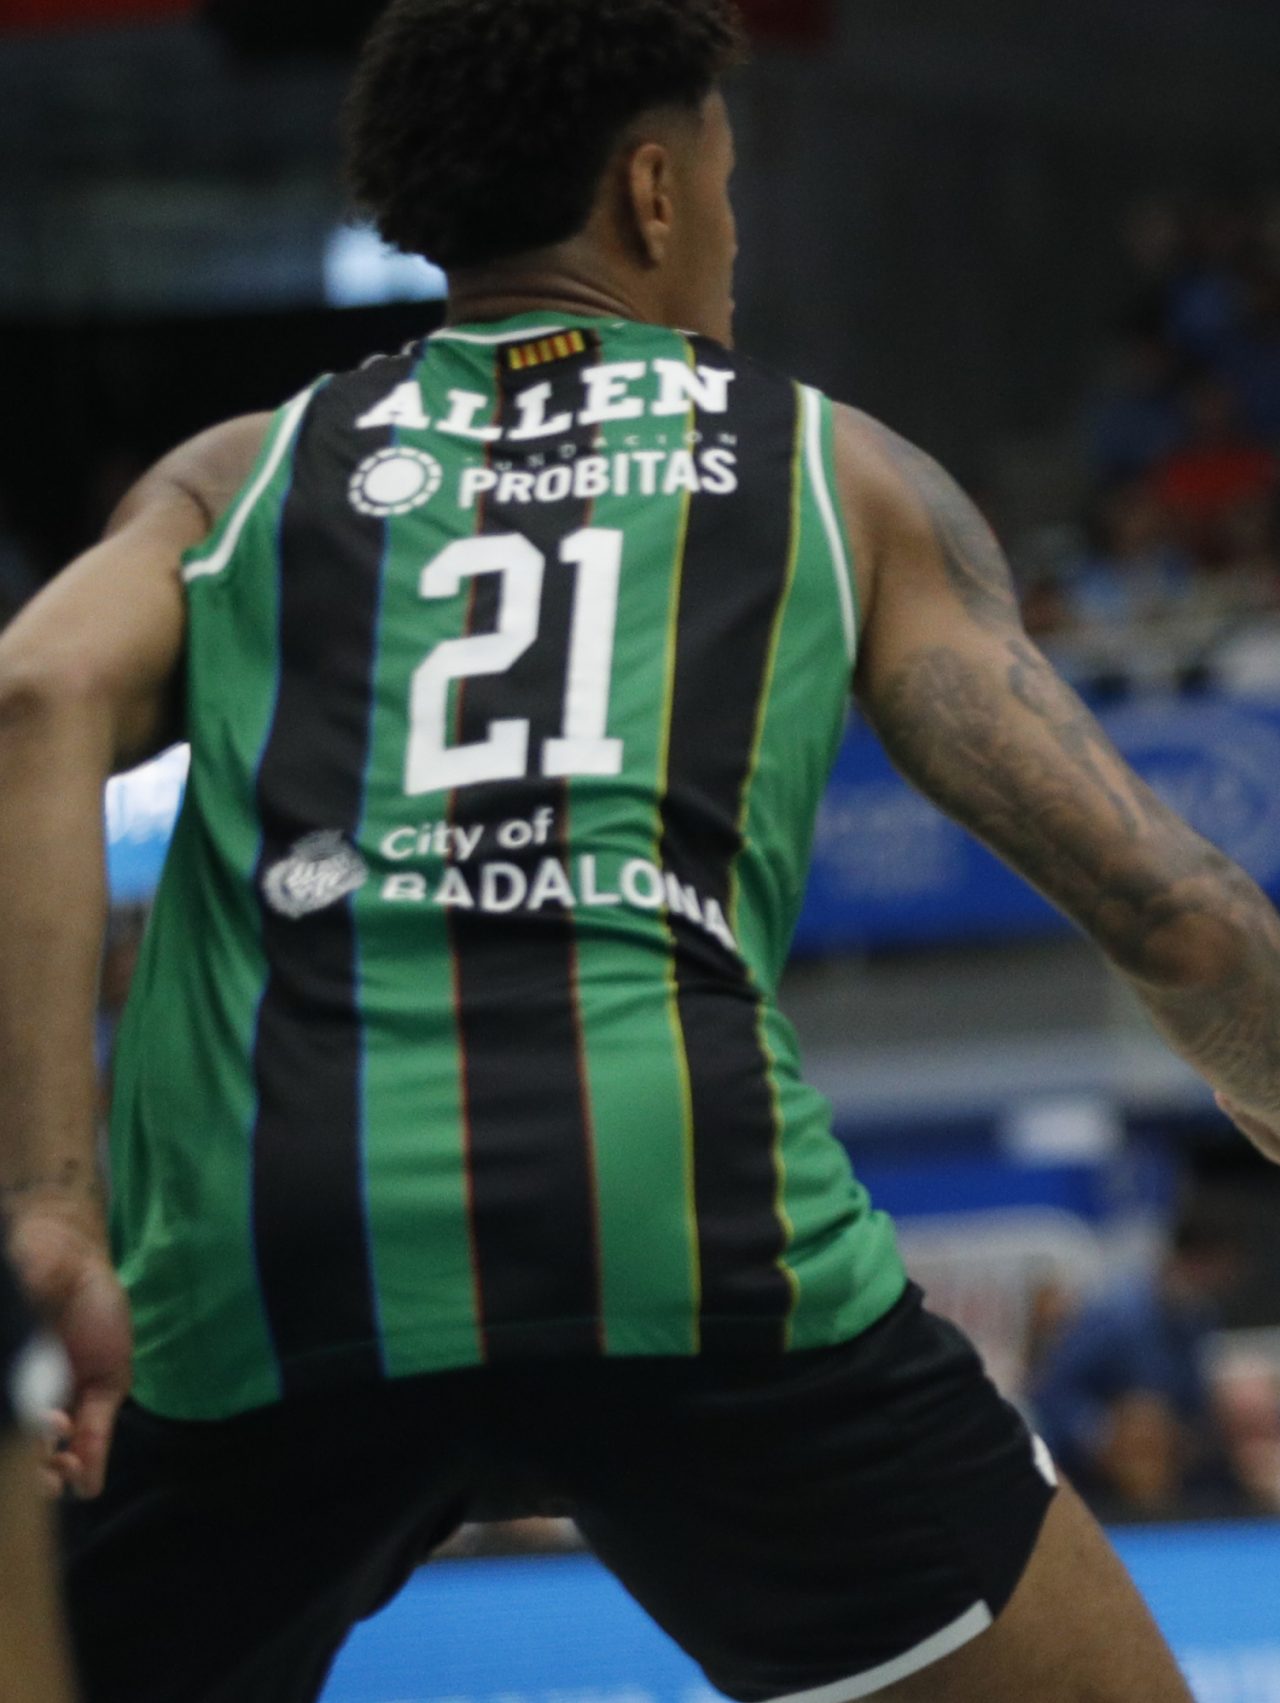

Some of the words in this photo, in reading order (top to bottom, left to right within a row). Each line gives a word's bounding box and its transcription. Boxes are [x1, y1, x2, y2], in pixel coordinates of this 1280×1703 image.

[355, 358, 737, 441] ALLEN
[458, 449, 738, 509] PROBITAS
[404, 526, 624, 796] 21
[380, 820, 485, 862] City
[496, 807, 555, 851] of
[381, 853, 738, 951] BADALONA
